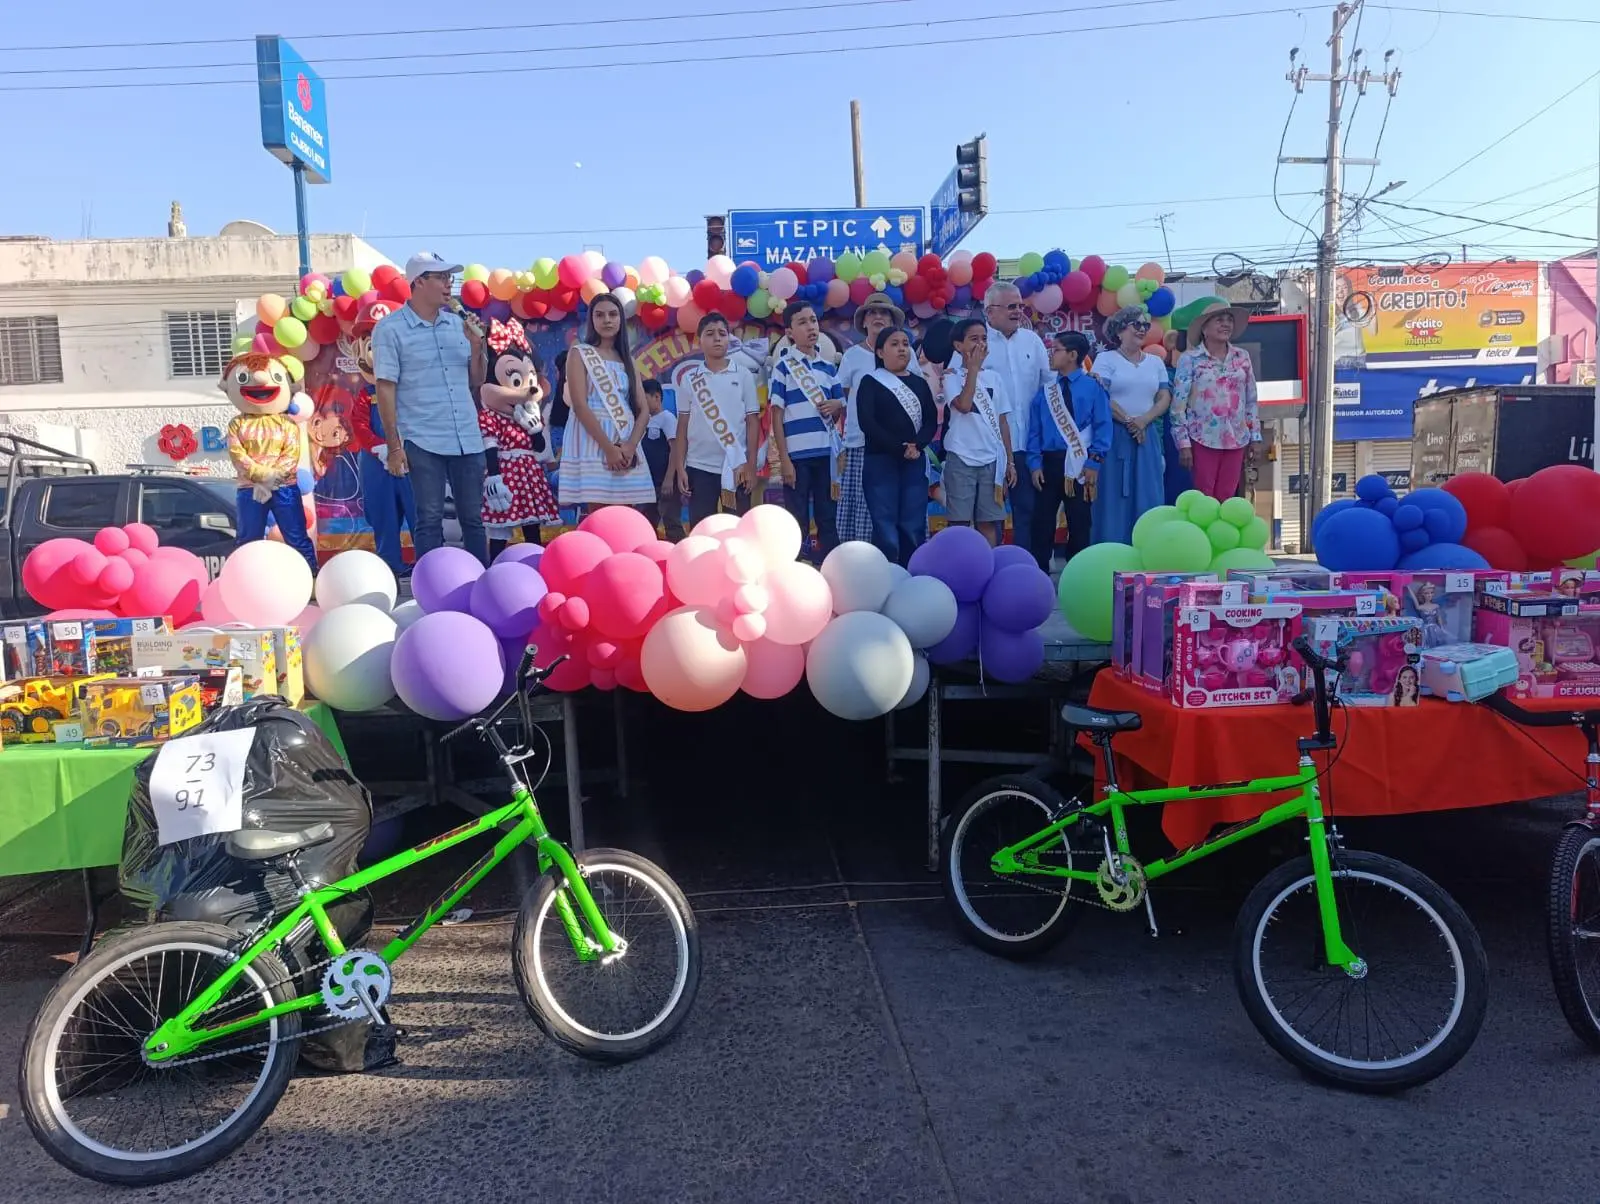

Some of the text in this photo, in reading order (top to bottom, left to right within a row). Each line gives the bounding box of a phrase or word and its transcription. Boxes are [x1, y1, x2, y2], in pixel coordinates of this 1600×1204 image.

[288, 100, 324, 149] Banamex
[774, 219, 857, 238] TEPIC
[1486, 347, 1512, 358] telcel
[582, 347, 629, 432] REGIDORA
[1333, 409, 1364, 417] RIBUIDOR
[1049, 383, 1085, 458] PRESIDENTE
[1456, 578, 1469, 588] 15
[1225, 591, 1232, 600] 9
[1360, 601, 1372, 610] 29
[1225, 608, 1263, 618] COOKING
[64, 626, 77, 636] 50
[135, 623, 148, 632] 58
[1320, 624, 1327, 634] 7
[137, 640, 173, 648] BUILDING
[240, 642, 251, 652] 52
[145, 688, 159, 698] 43
[1212, 692, 1251, 702] KITCHEN
[1253, 690, 1272, 700] SET
[1560, 687, 1573, 696] DE
[65, 728, 78, 738] 49
[185, 752, 216, 773] 73
[175, 788, 204, 811] 91
